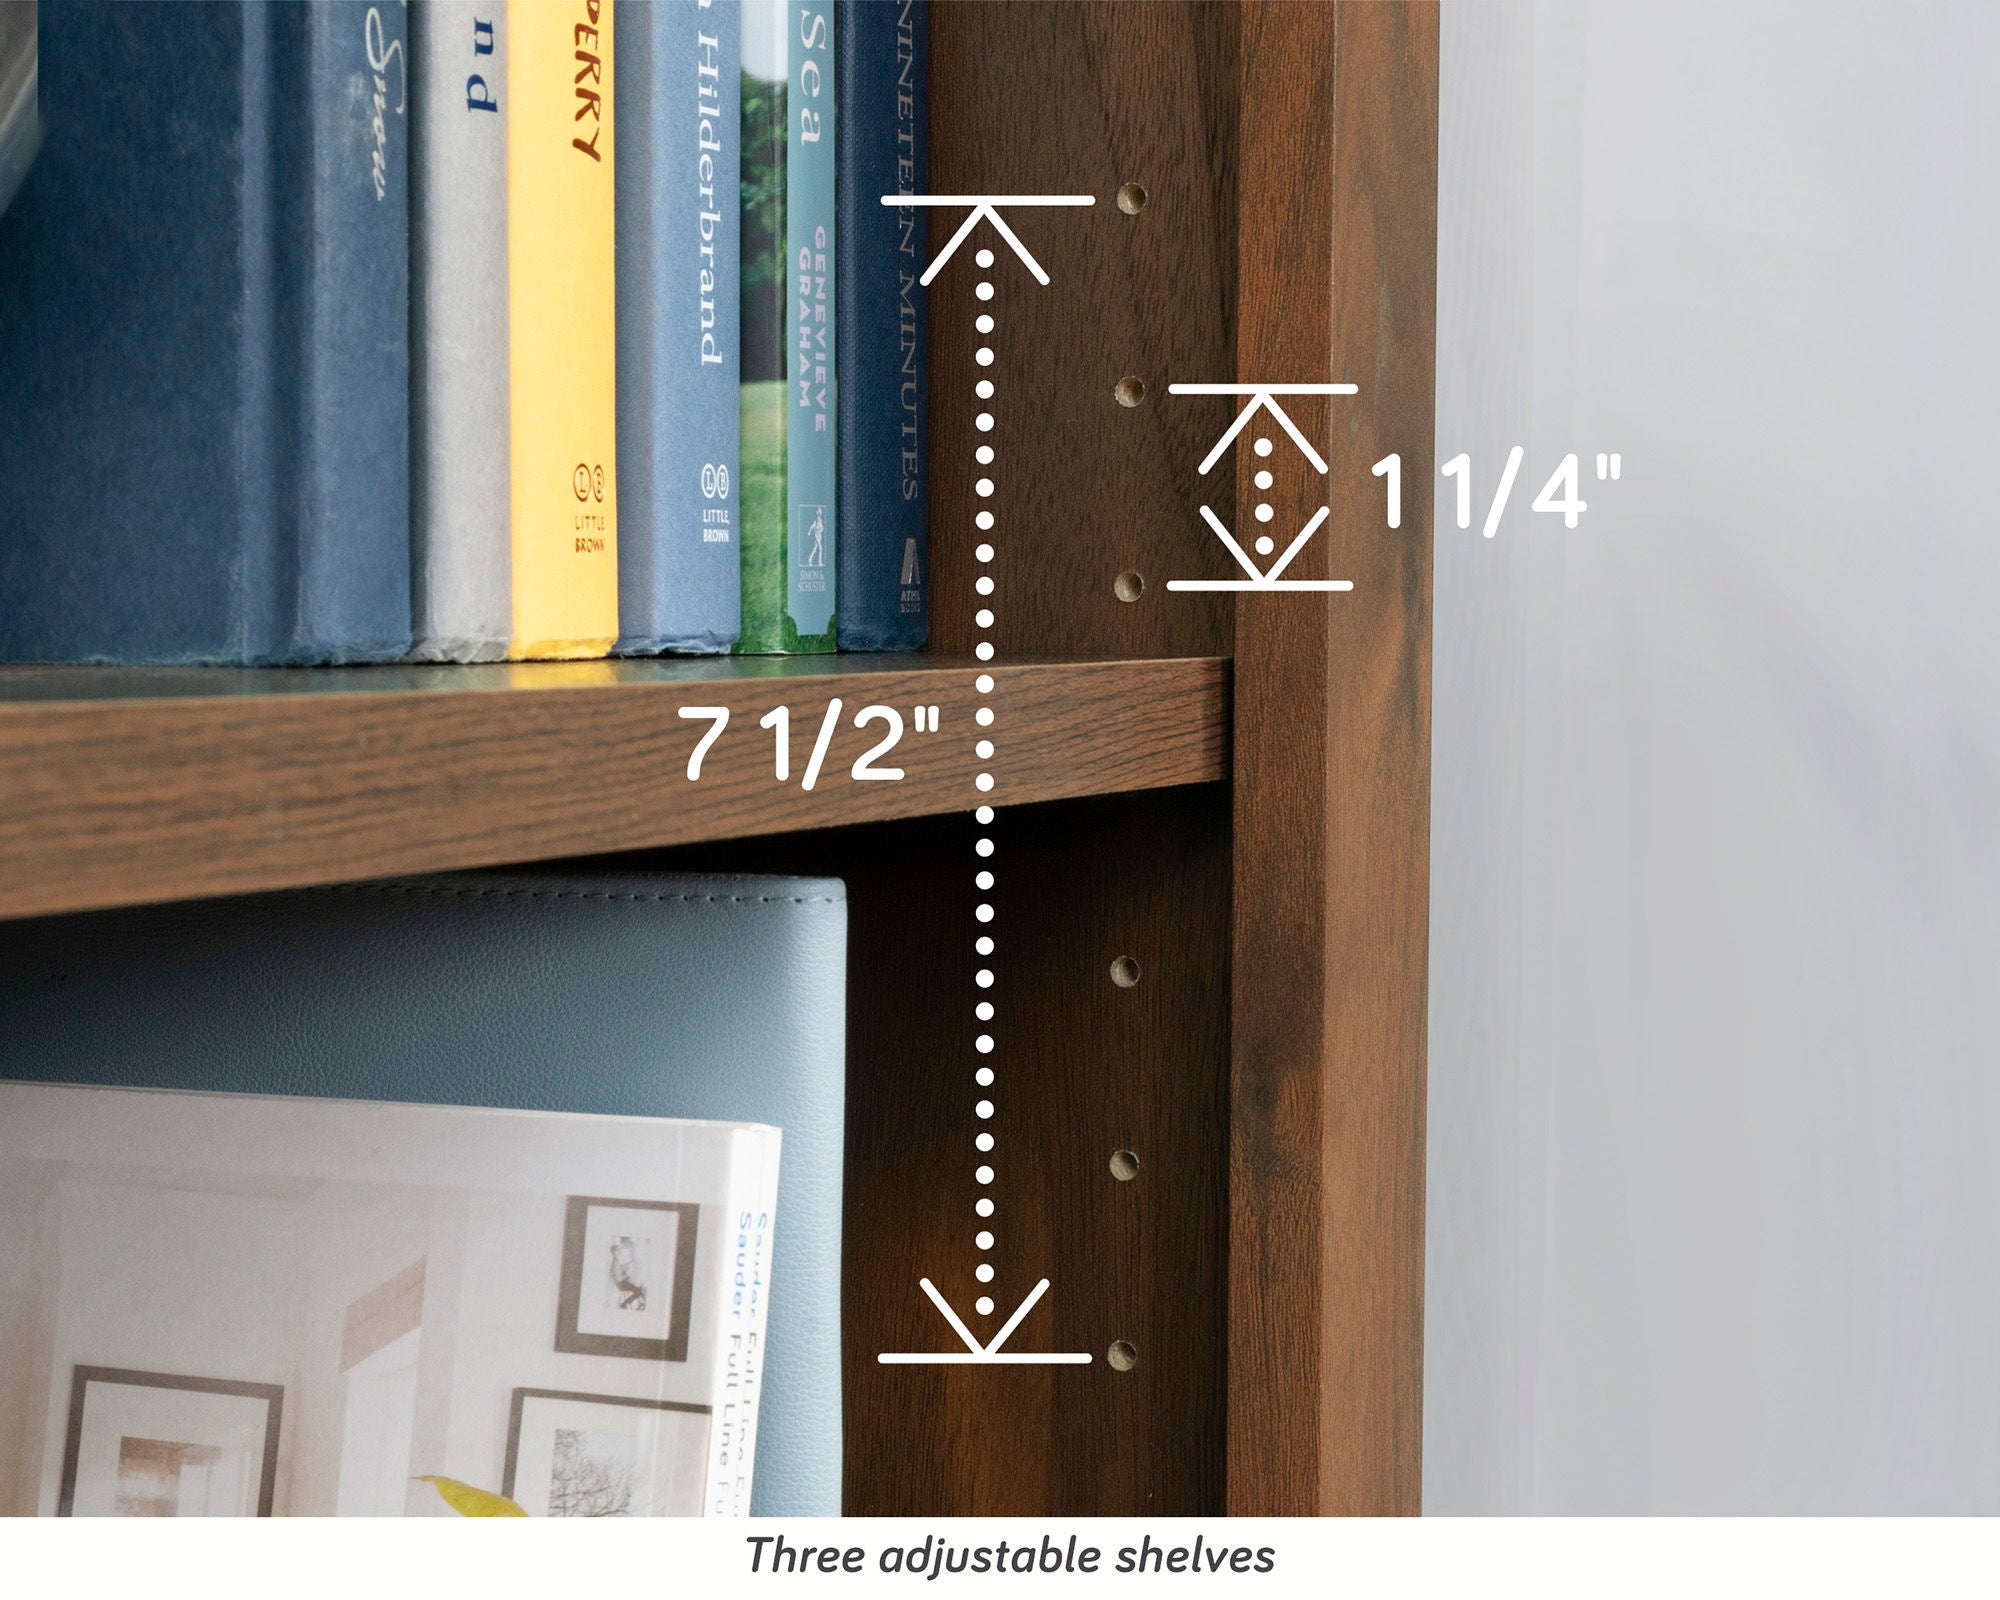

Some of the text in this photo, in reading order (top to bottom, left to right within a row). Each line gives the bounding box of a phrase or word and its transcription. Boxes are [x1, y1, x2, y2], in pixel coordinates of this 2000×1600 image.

[800, 9, 826, 147] Sea
[698, 30, 723, 367] Hilderbrand
[799, 246, 812, 407] GRAHAM
[814, 225, 827, 432] GENEVIEVE
[900, 270, 918, 501] MINUTES
[575, 537, 605, 554] BROWN
[703, 529, 730, 543] BROWN
[733, 1211, 752, 1320] Sauder
[726, 1334, 742, 1389] Full
[719, 1403, 736, 1466] Line
